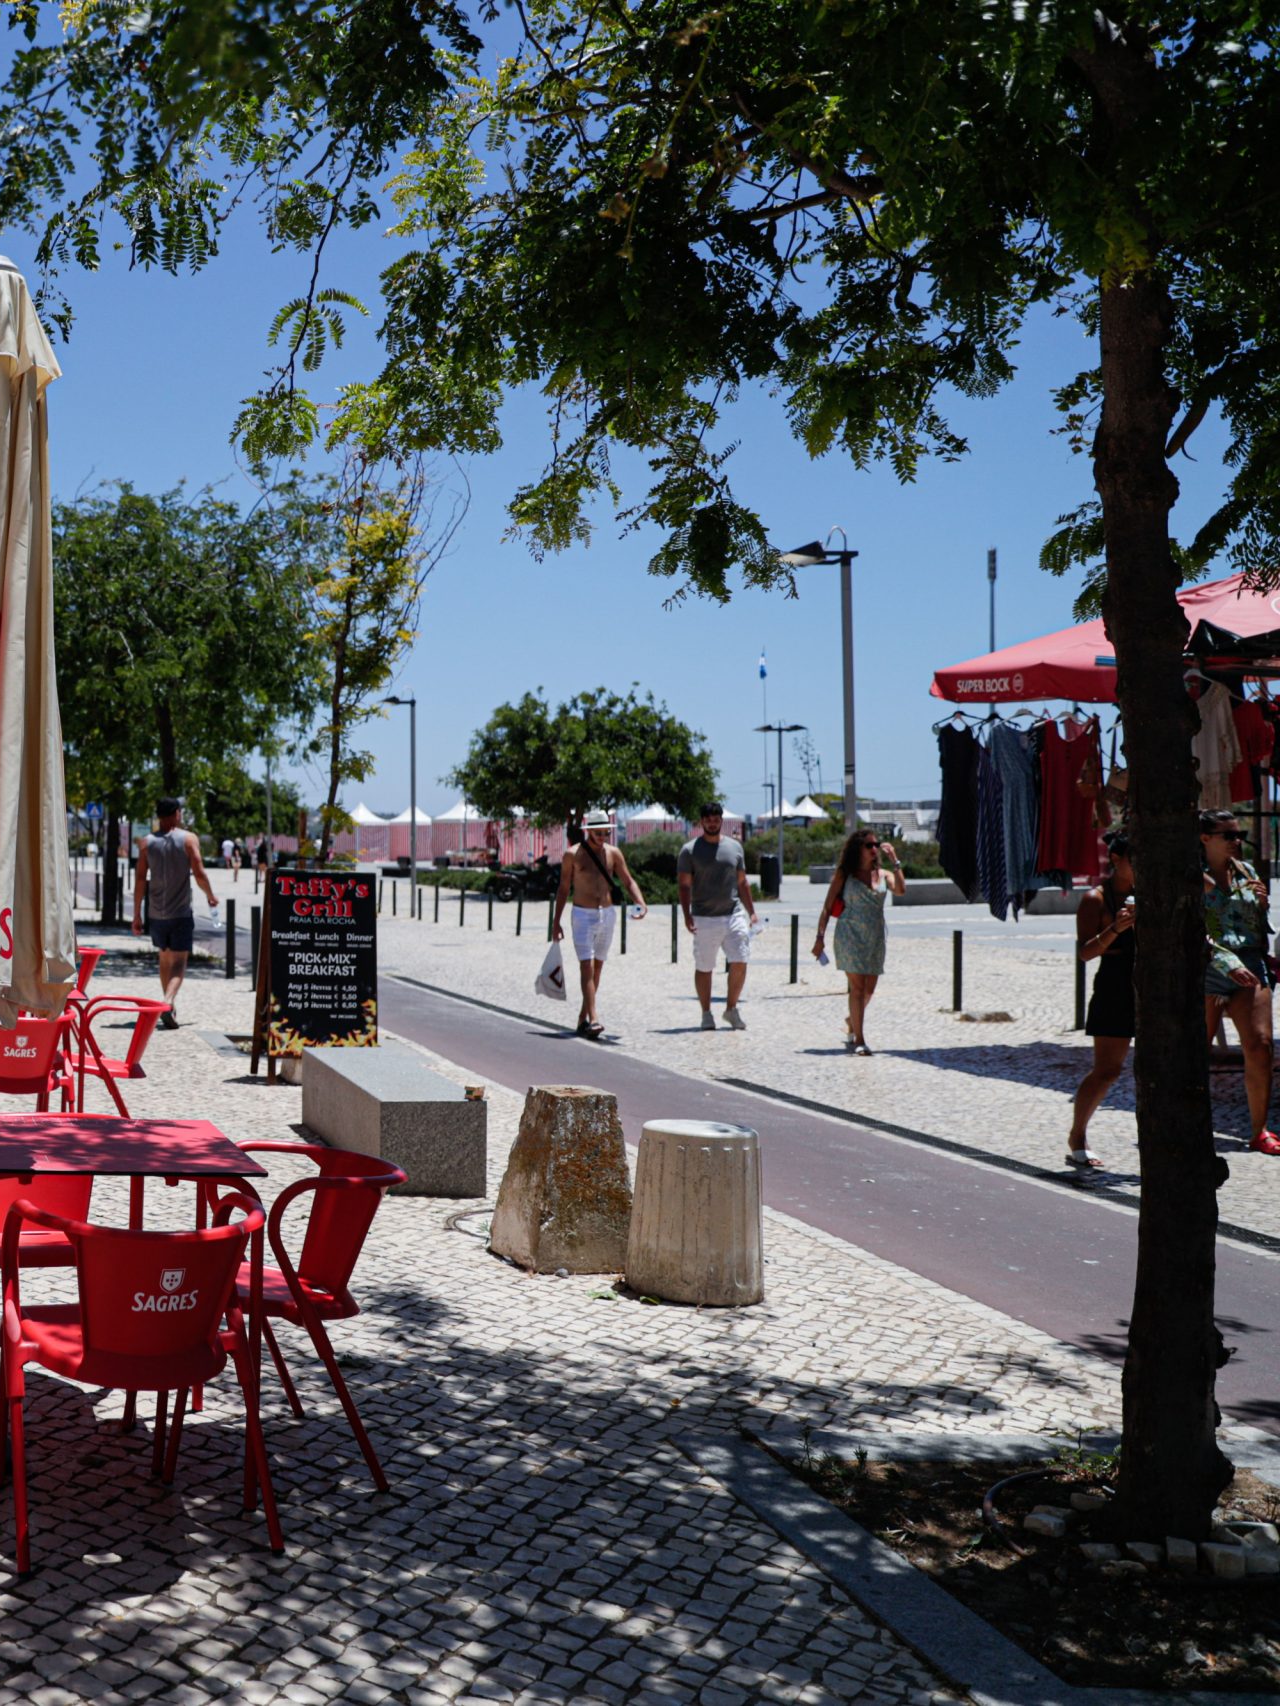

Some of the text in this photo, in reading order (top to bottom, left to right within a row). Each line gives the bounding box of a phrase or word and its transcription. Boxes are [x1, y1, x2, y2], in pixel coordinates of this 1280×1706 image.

[957, 677, 1010, 693] SUPER BOCK
[275, 876, 370, 901] Taffy's
[293, 898, 353, 918] Grill
[289, 915, 357, 925] PRAIA DA ROCHA
[271, 930, 310, 941] Breakfast
[314, 931, 340, 942] Lunch
[346, 932, 374, 942] Dinner
[288, 964, 357, 977] BREAKFAST
[288, 982, 303, 991] Any
[310, 983, 332, 991] items
[288, 991, 303, 1001] Any
[310, 992, 332, 1000] items
[288, 1000, 303, 1010] Any
[310, 1001, 332, 1009] items
[3, 1046, 37, 1058] SAGRES
[131, 1289, 199, 1314] SAGRES
